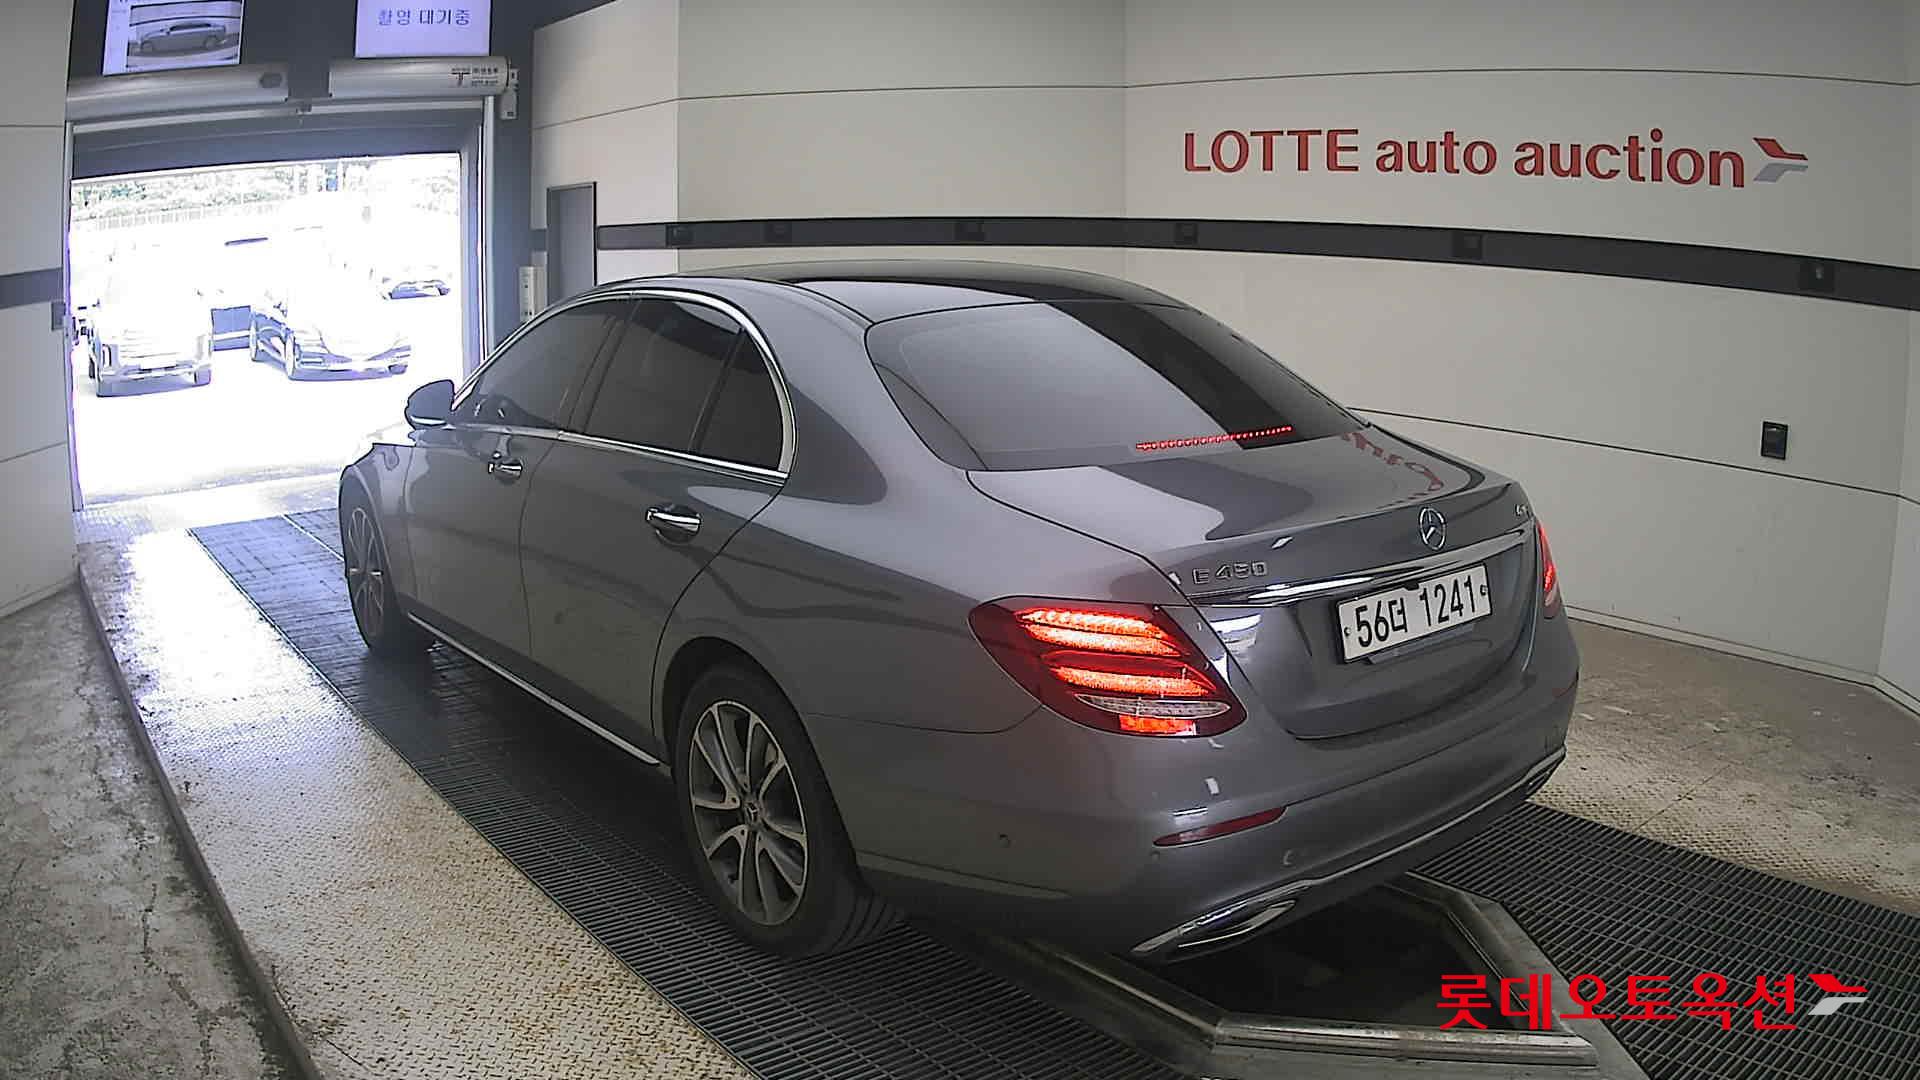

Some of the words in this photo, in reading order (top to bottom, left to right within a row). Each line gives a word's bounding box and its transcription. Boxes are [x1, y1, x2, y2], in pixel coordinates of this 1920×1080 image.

[419, 9, 470, 26] 대기중
[1184, 129, 1359, 172] LOTTE
[1375, 131, 1497, 175] auto
[1514, 128, 1745, 188] auction
[1355, 597, 1408, 647] 56더
[1419, 575, 1475, 626] 1241
